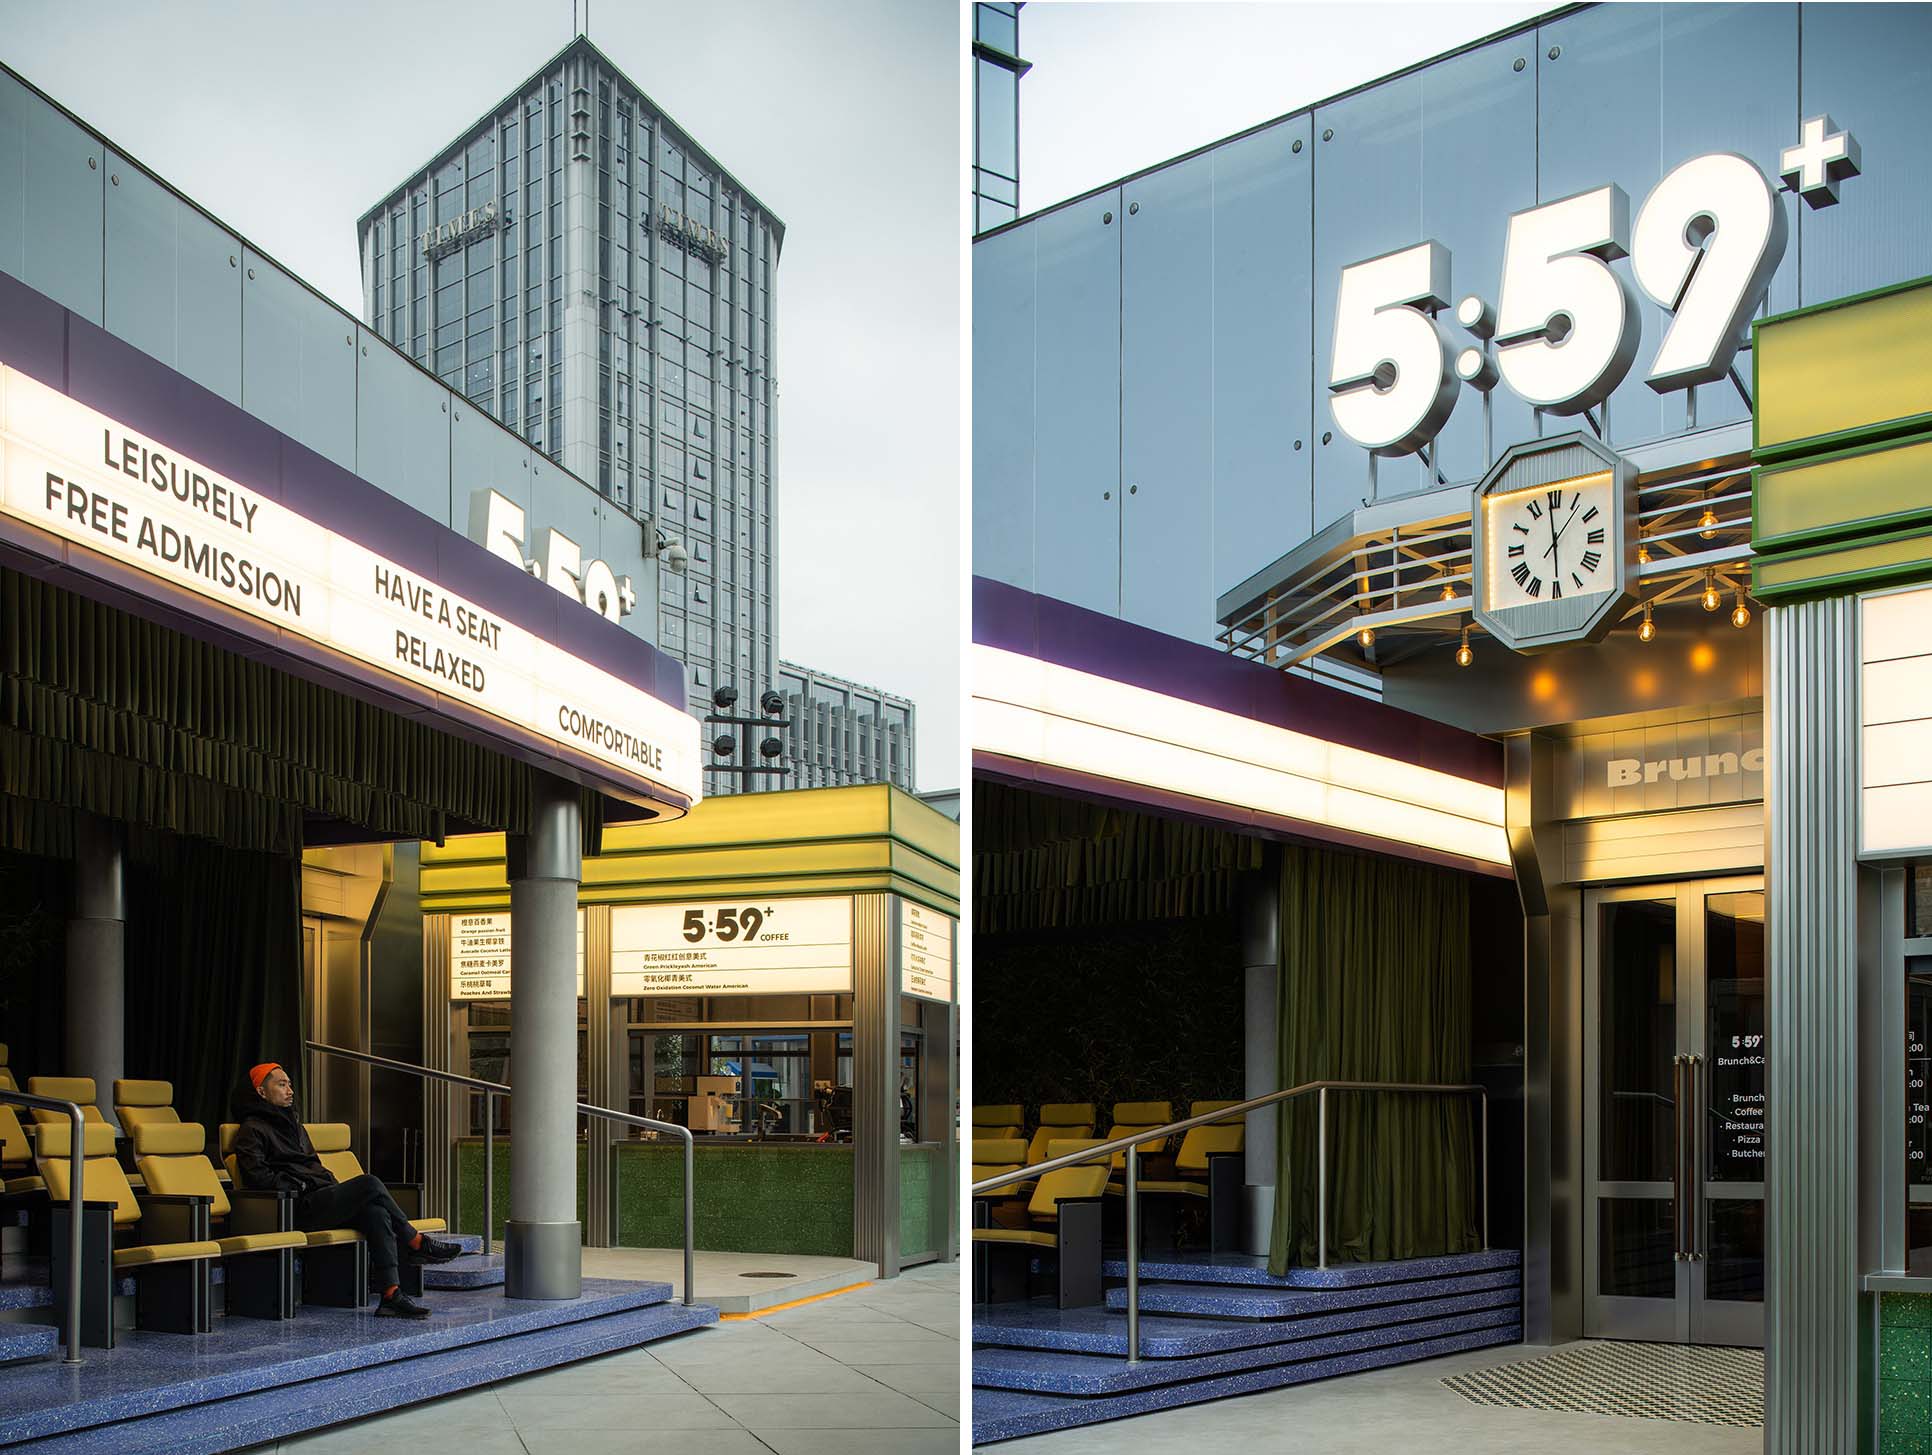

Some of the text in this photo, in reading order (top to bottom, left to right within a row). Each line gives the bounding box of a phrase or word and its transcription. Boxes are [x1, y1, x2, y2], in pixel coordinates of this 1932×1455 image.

[421, 200, 498, 253] TIMES
[657, 202, 728, 254] TIMES
[1328, 113, 1859, 456] 5:59+
[104, 428, 258, 533] LEISURELY
[46, 471, 301, 617] FREE ADMISSION
[375, 564, 501, 651] HAVE A SEAT
[396, 629, 485, 693] RELAXED
[558, 704, 663, 772] COMFORTABLE
[683, 906, 789, 943] 5:59+ COFFEE
[1733, 1093, 1765, 1102] Brunch
[1735, 1108, 1763, 1116] Coffee
[1913, 1104, 1930, 1112] Tea
